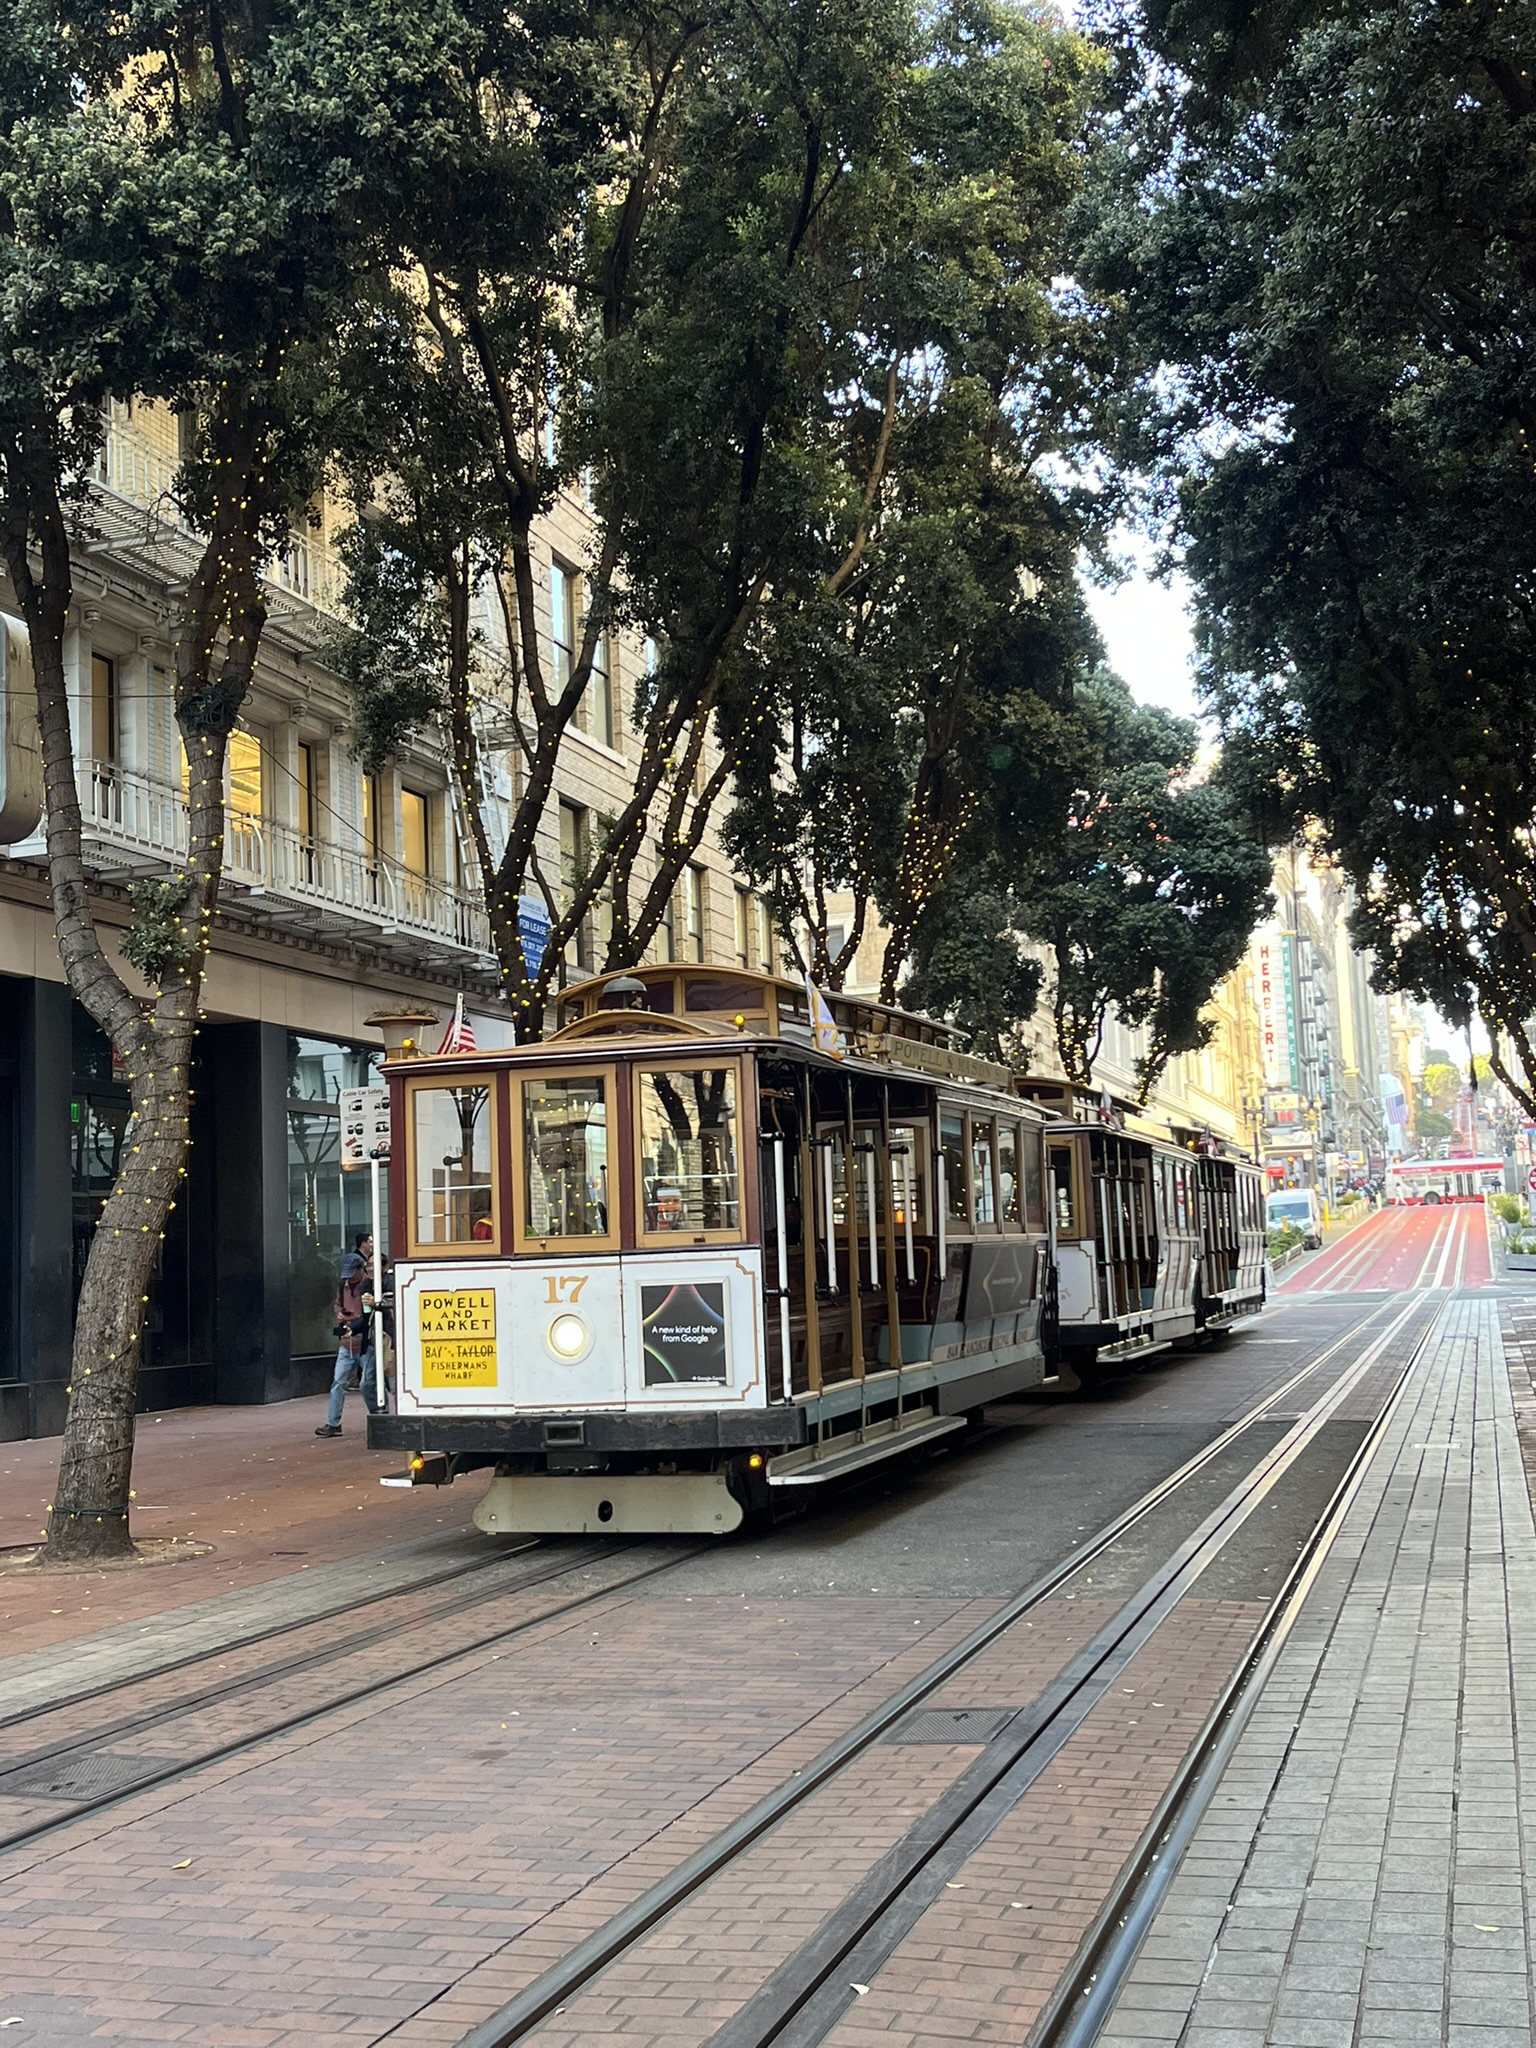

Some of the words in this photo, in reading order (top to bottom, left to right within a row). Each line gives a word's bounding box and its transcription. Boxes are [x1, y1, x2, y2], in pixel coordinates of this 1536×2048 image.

[519, 918, 530, 931] FOR
[530, 922, 547, 936] LEASE
[1260, 945, 1275, 1063] HERBERT
[1286, 993, 1297, 1066] BARNES
[894, 1040, 942, 1067] POWELL
[958, 1057, 991, 1079] MASON
[368, 1088, 384, 1096] Safety
[543, 1275, 589, 1303] 17
[423, 1297, 489, 1309] POWELL
[441, 1310, 473, 1319] AND
[422, 1319, 490, 1331] MARKET
[651, 1325, 658, 1334] A
[675, 1325, 691, 1334] kind
[691, 1325, 701, 1334] of
[701, 1325, 718, 1335] help
[662, 1334, 680, 1343] from
[680, 1334, 709, 1345] Google
[425, 1346, 442, 1358] BAY
[431, 1361, 487, 1370] FISHERMANS
[444, 1371, 473, 1379] WHARF
